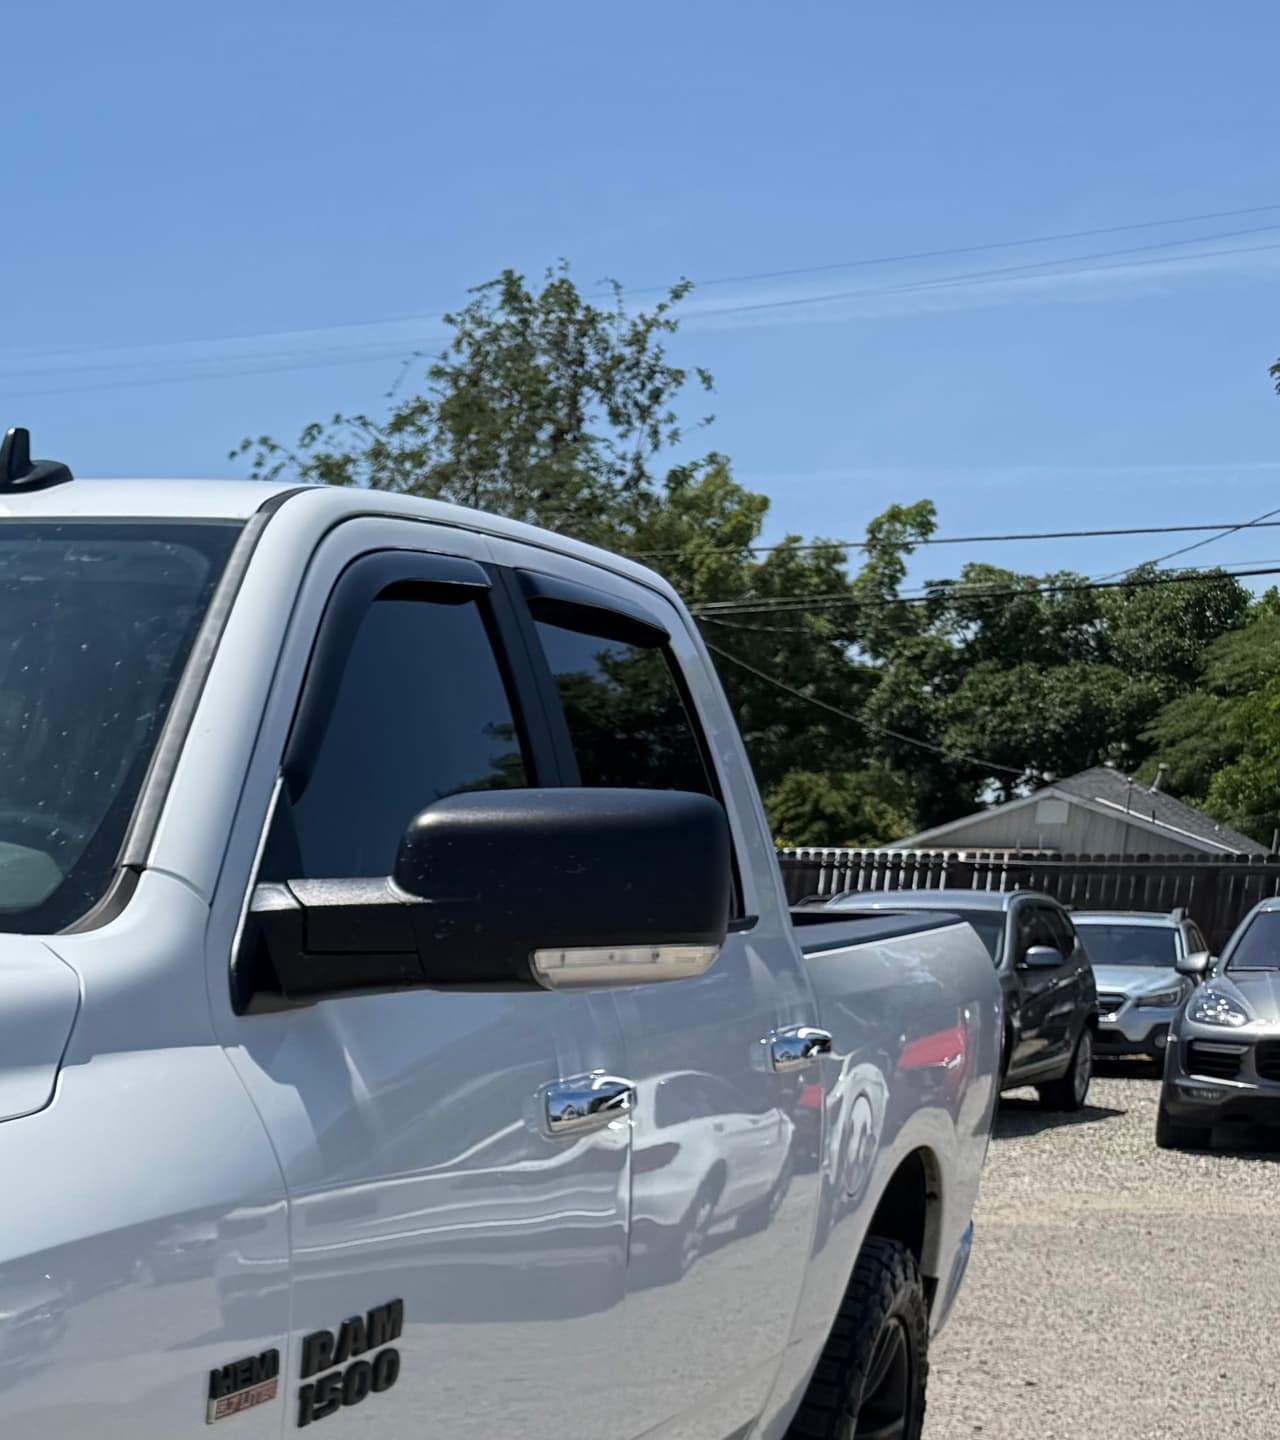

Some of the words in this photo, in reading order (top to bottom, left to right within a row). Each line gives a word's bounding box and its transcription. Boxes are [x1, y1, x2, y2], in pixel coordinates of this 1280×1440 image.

[209, 1348, 279, 1400] HEMI
[300, 1298, 403, 1379] RAM
[297, 1348, 400, 1428] 1500
